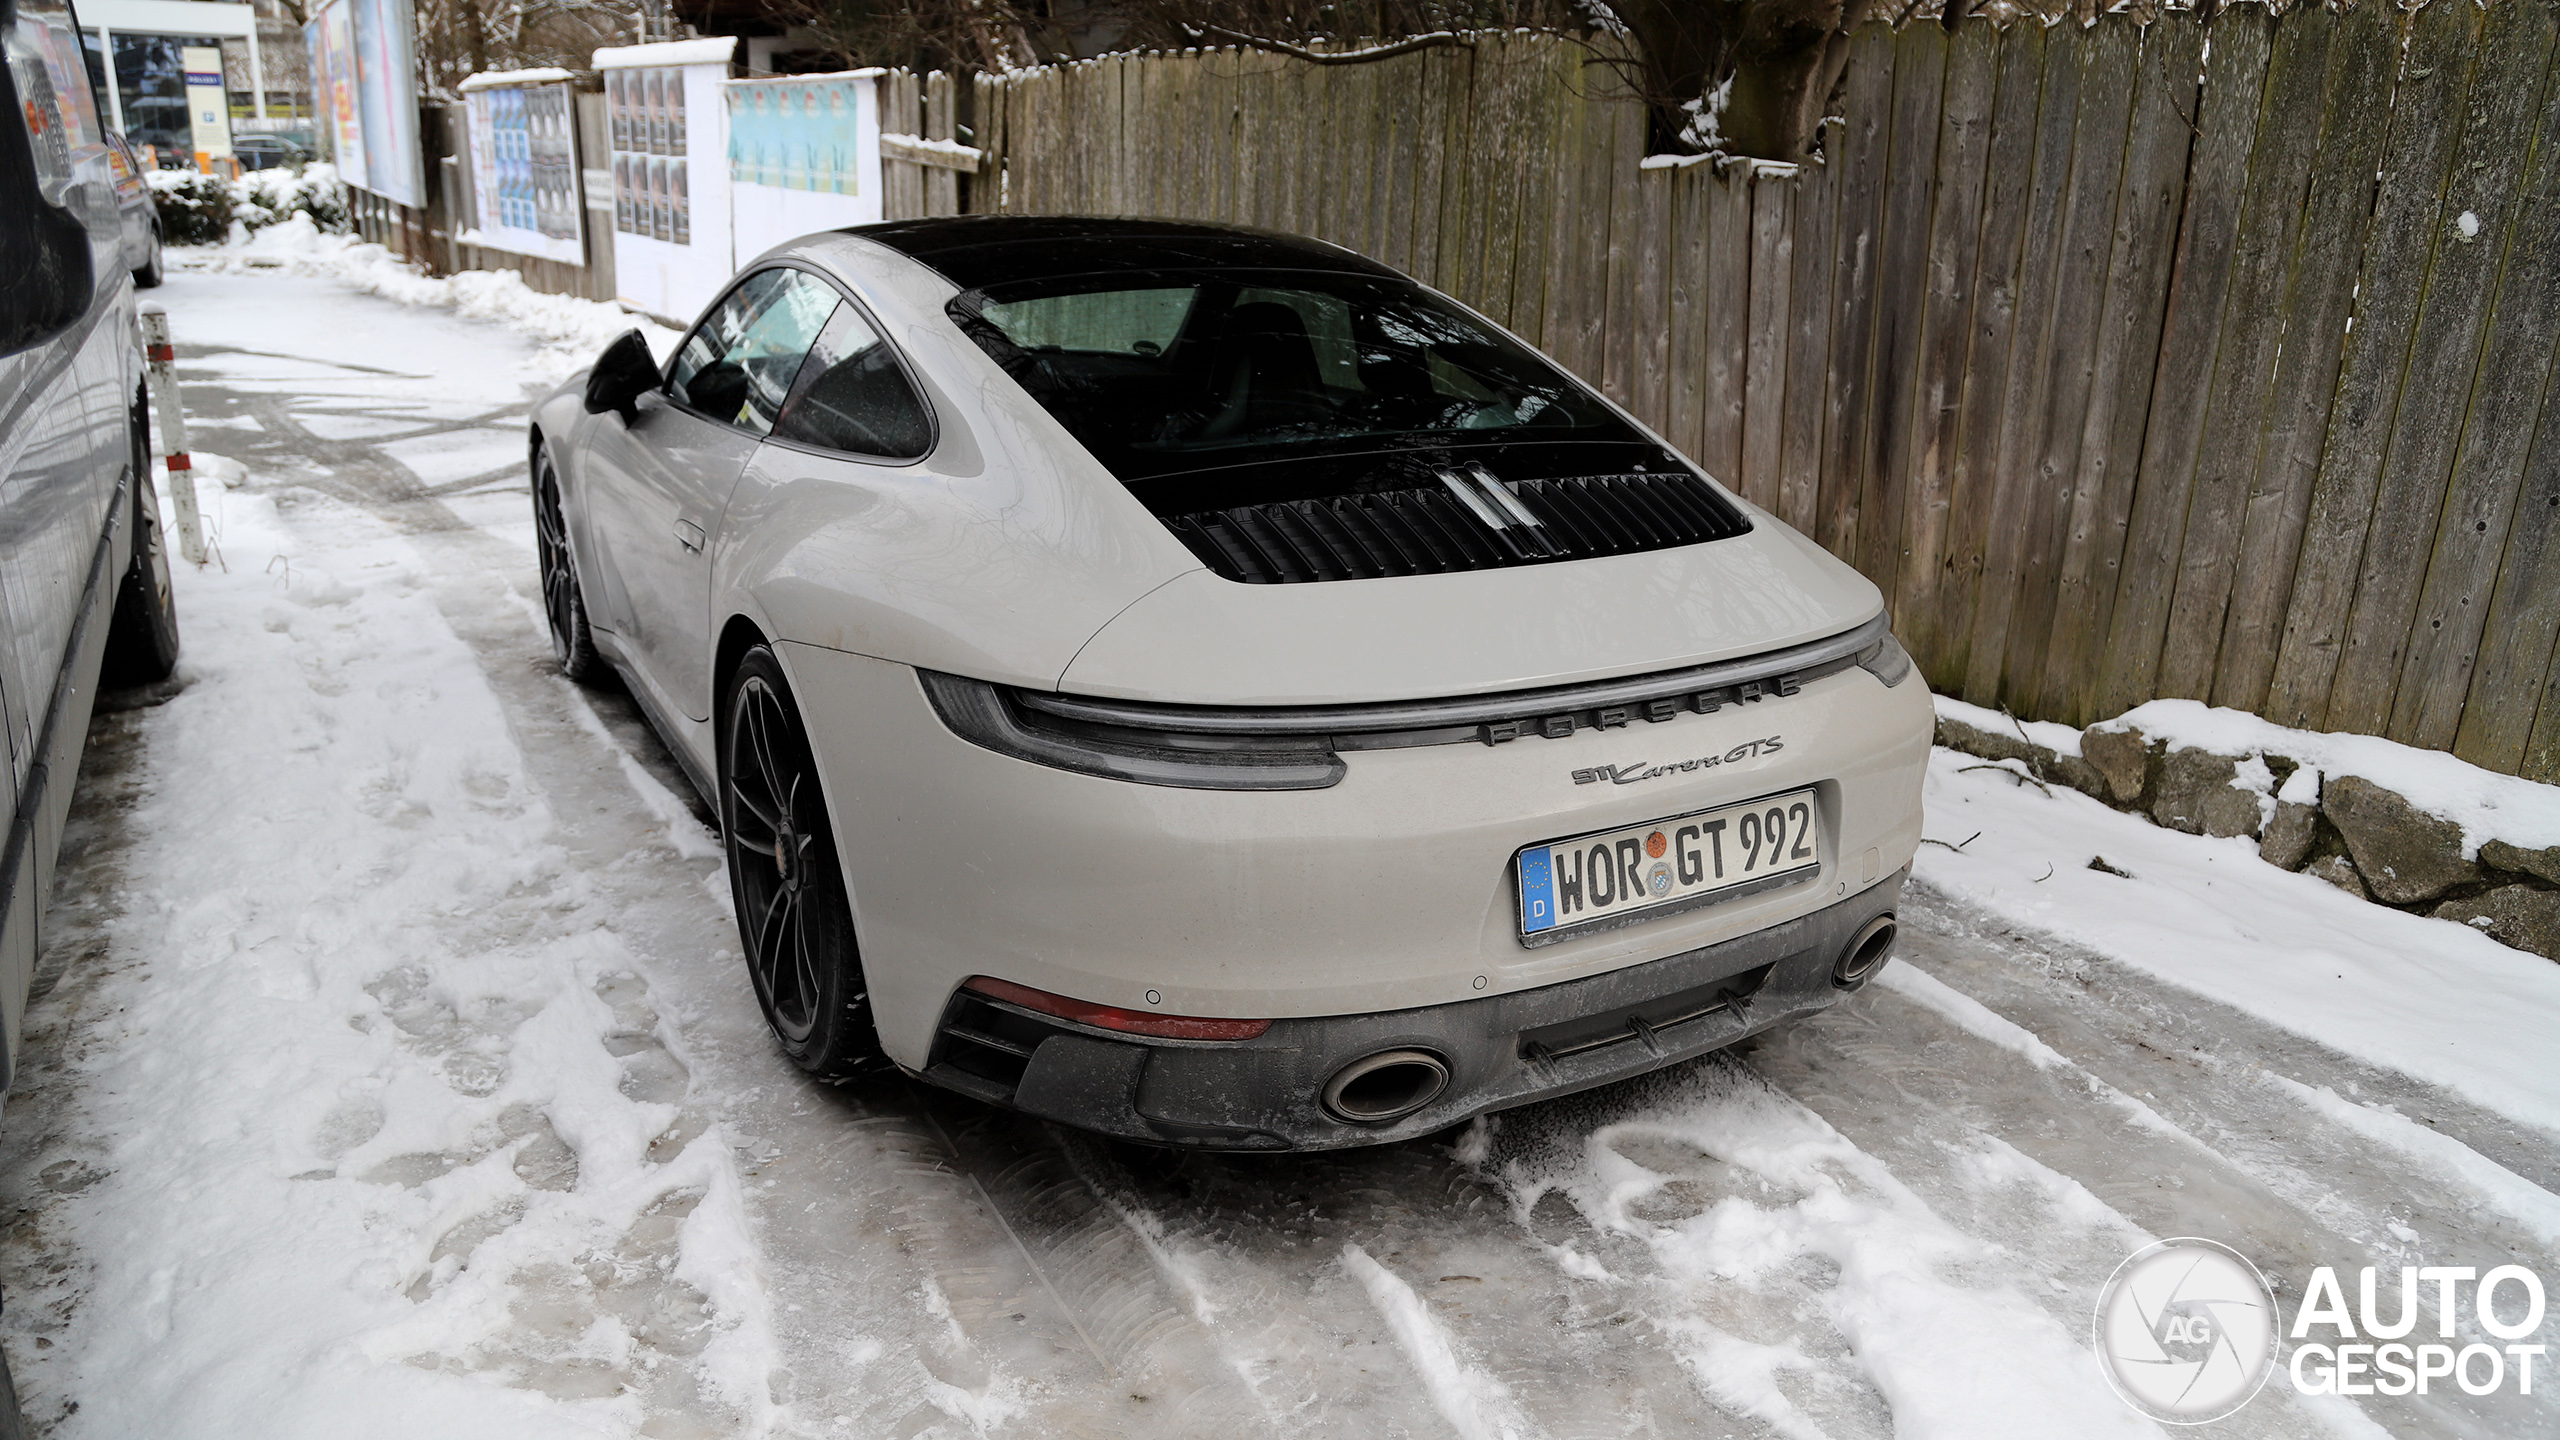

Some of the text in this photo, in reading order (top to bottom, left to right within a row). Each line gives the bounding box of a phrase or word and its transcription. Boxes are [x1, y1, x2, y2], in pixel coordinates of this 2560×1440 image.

[1480, 674, 1800, 746] PORSCHE
[1571, 735, 1784, 785] 911 Carrera GTS
[1555, 838, 1646, 916] WOR
[1675, 818, 1727, 887] GT
[1739, 802, 1812, 872] 992
[1533, 899, 1545, 918] D
